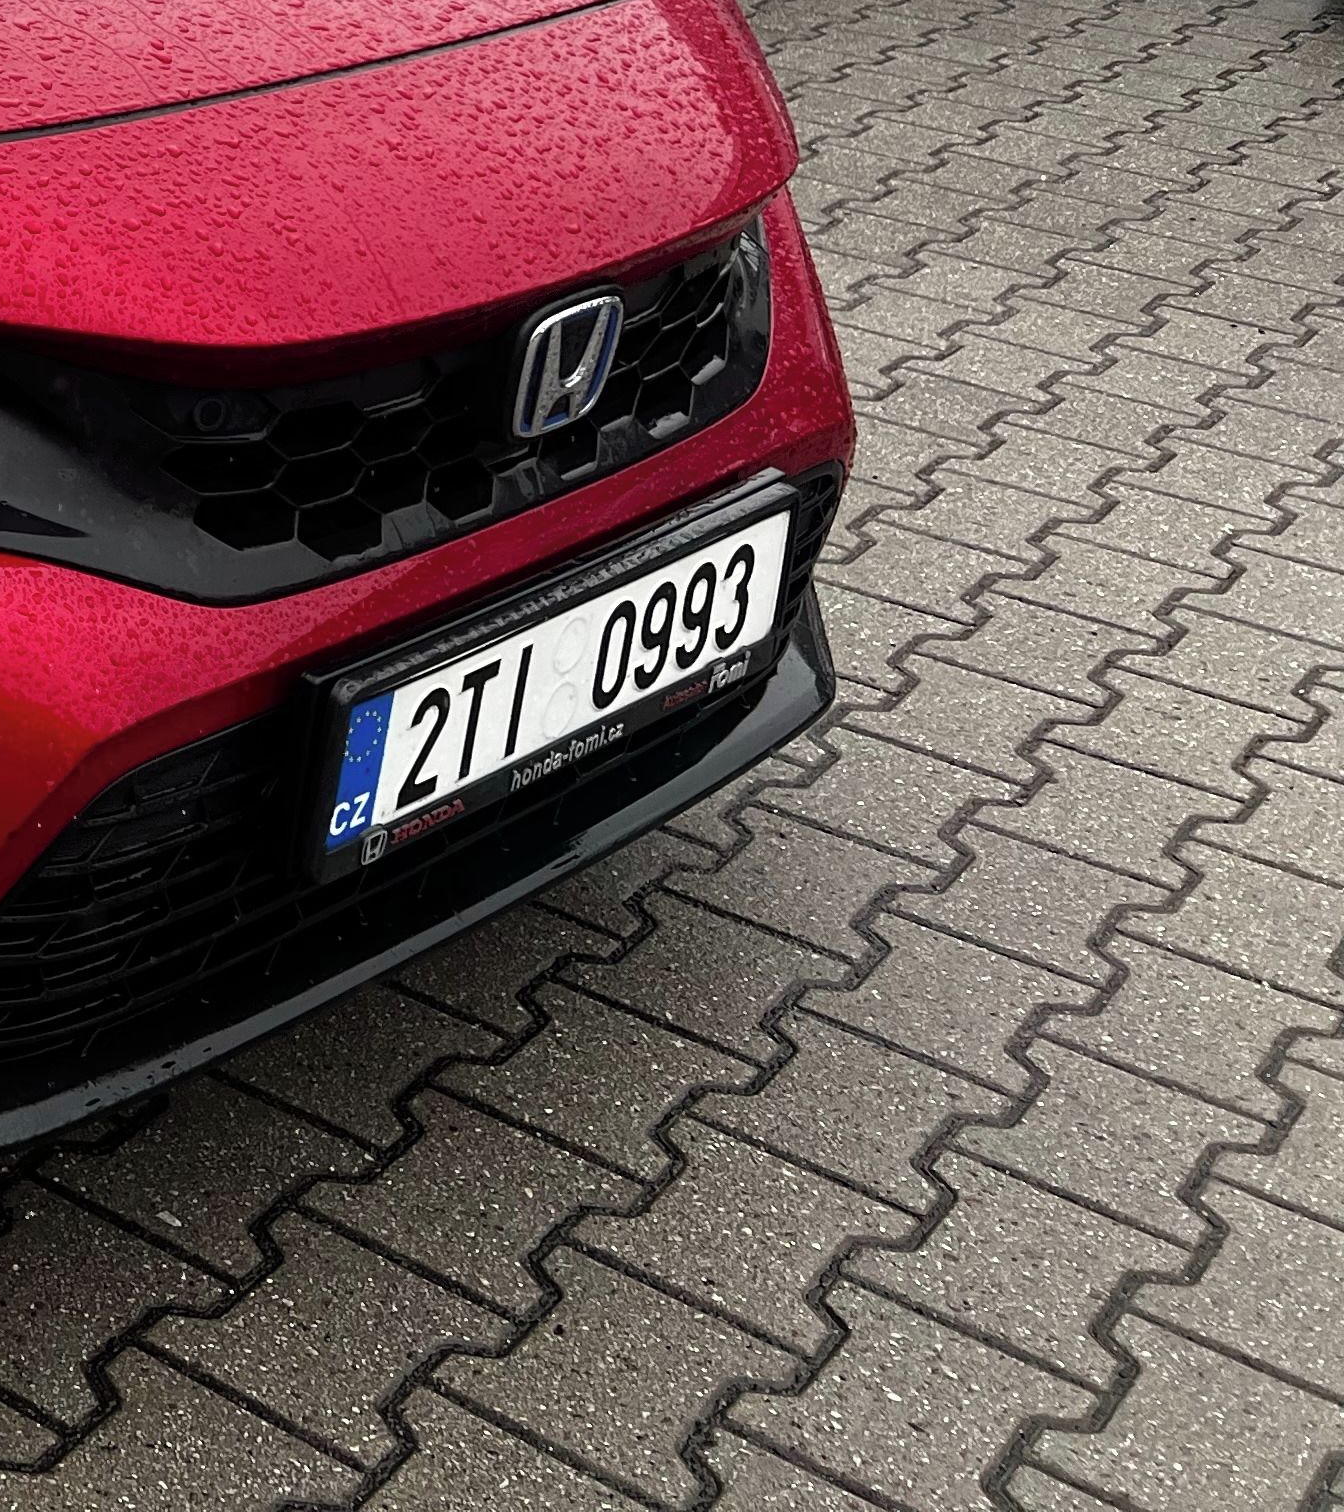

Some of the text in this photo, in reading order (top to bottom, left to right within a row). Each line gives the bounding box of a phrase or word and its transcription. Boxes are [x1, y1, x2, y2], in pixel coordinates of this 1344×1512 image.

[395, 543, 755, 811] 2TI 0993
[510, 723, 625, 792] honda-fomi.cz
[328, 792, 371, 837] CZ
[390, 798, 466, 846] HONDA
